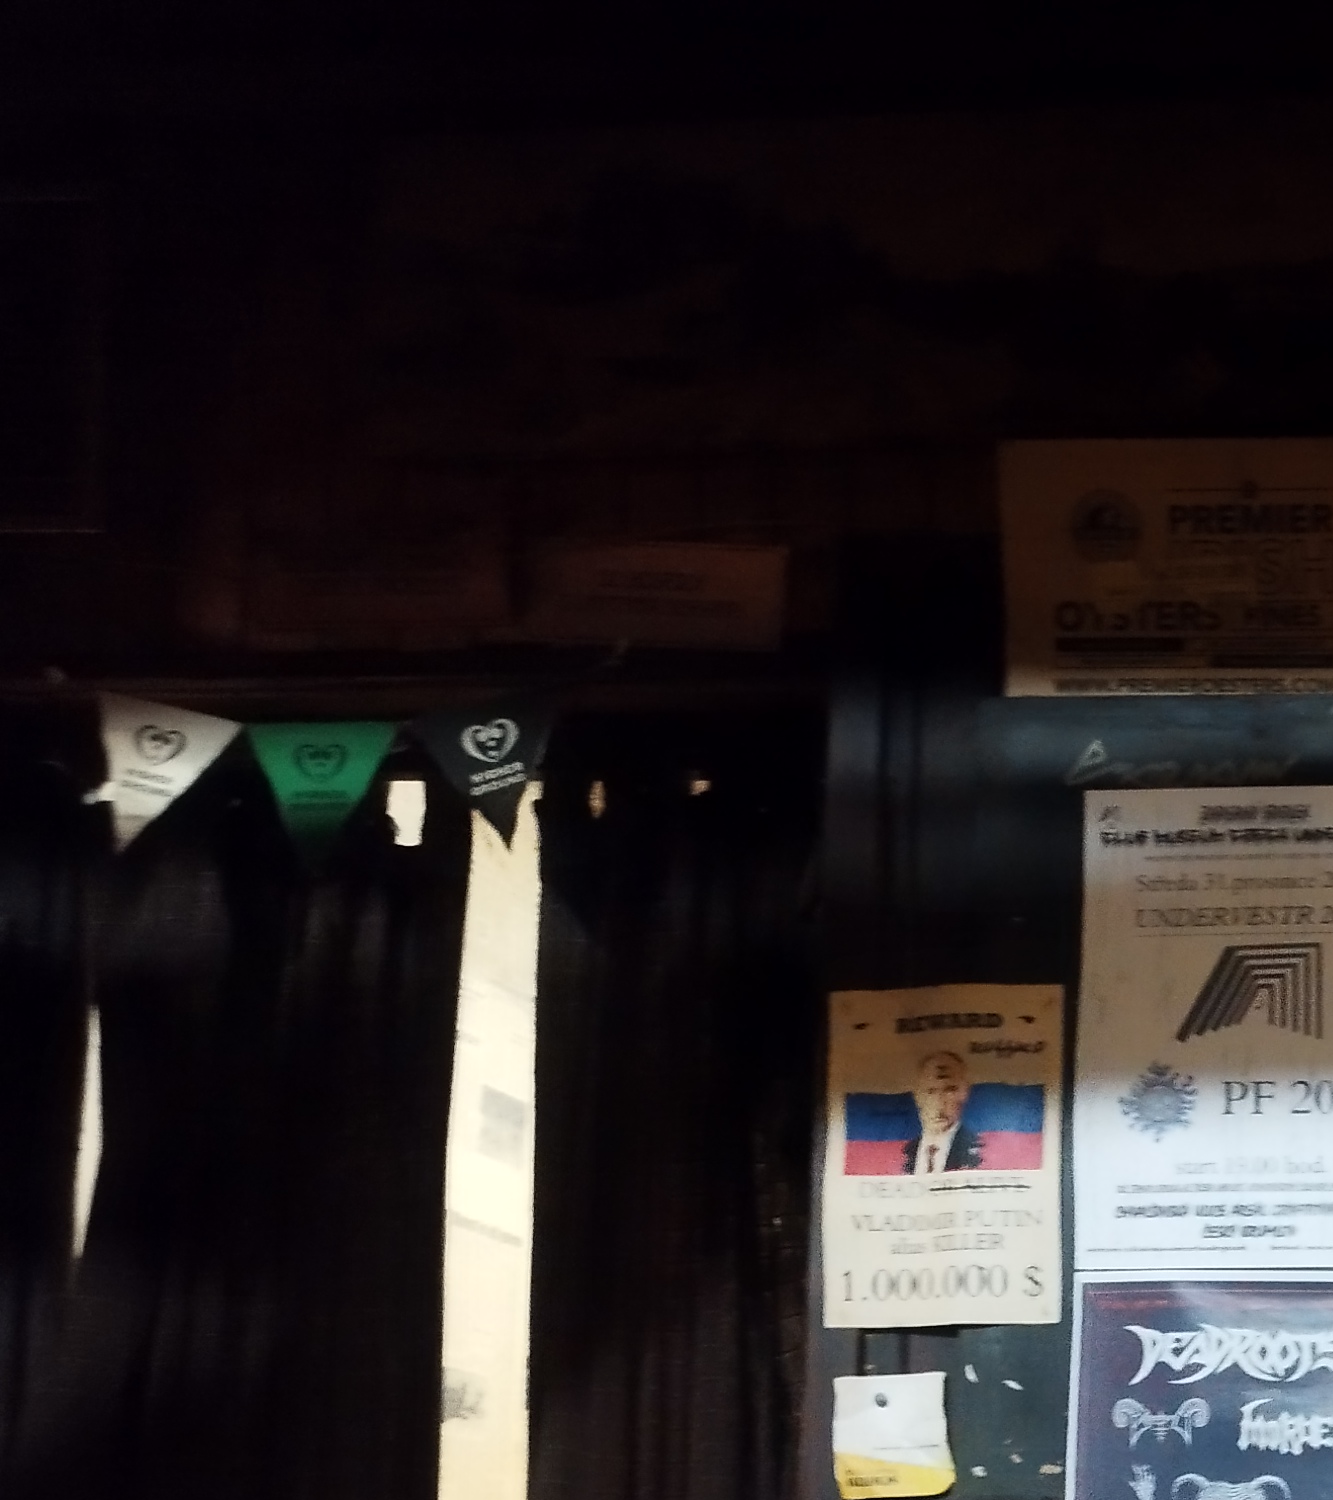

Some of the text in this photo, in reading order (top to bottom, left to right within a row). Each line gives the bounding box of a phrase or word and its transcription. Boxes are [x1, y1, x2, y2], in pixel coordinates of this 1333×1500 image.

[1221, 1080, 1275, 1115] PF
[963, 1209, 1044, 1228] PUTIN
[841, 1264, 1046, 1302] 1.000.000 $
